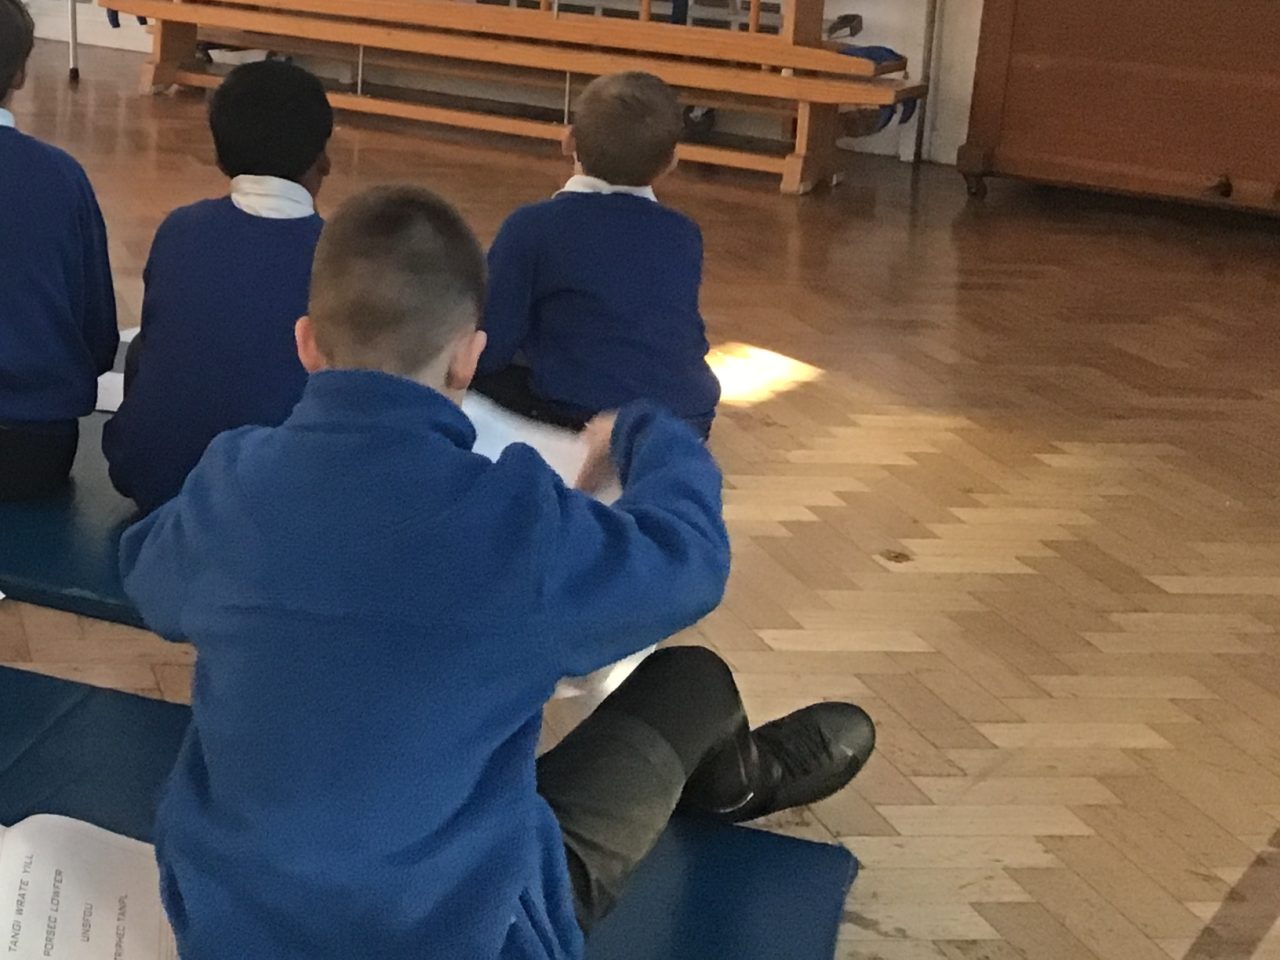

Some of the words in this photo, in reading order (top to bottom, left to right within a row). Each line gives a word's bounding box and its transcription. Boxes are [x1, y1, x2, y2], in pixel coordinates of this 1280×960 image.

[21, 854, 34, 875] YILL
[14, 878, 30, 916] WRATE
[50, 868, 64, 913] LOWFER
[7, 919, 22, 952] TANGI
[43, 915, 58, 957] PORSEC
